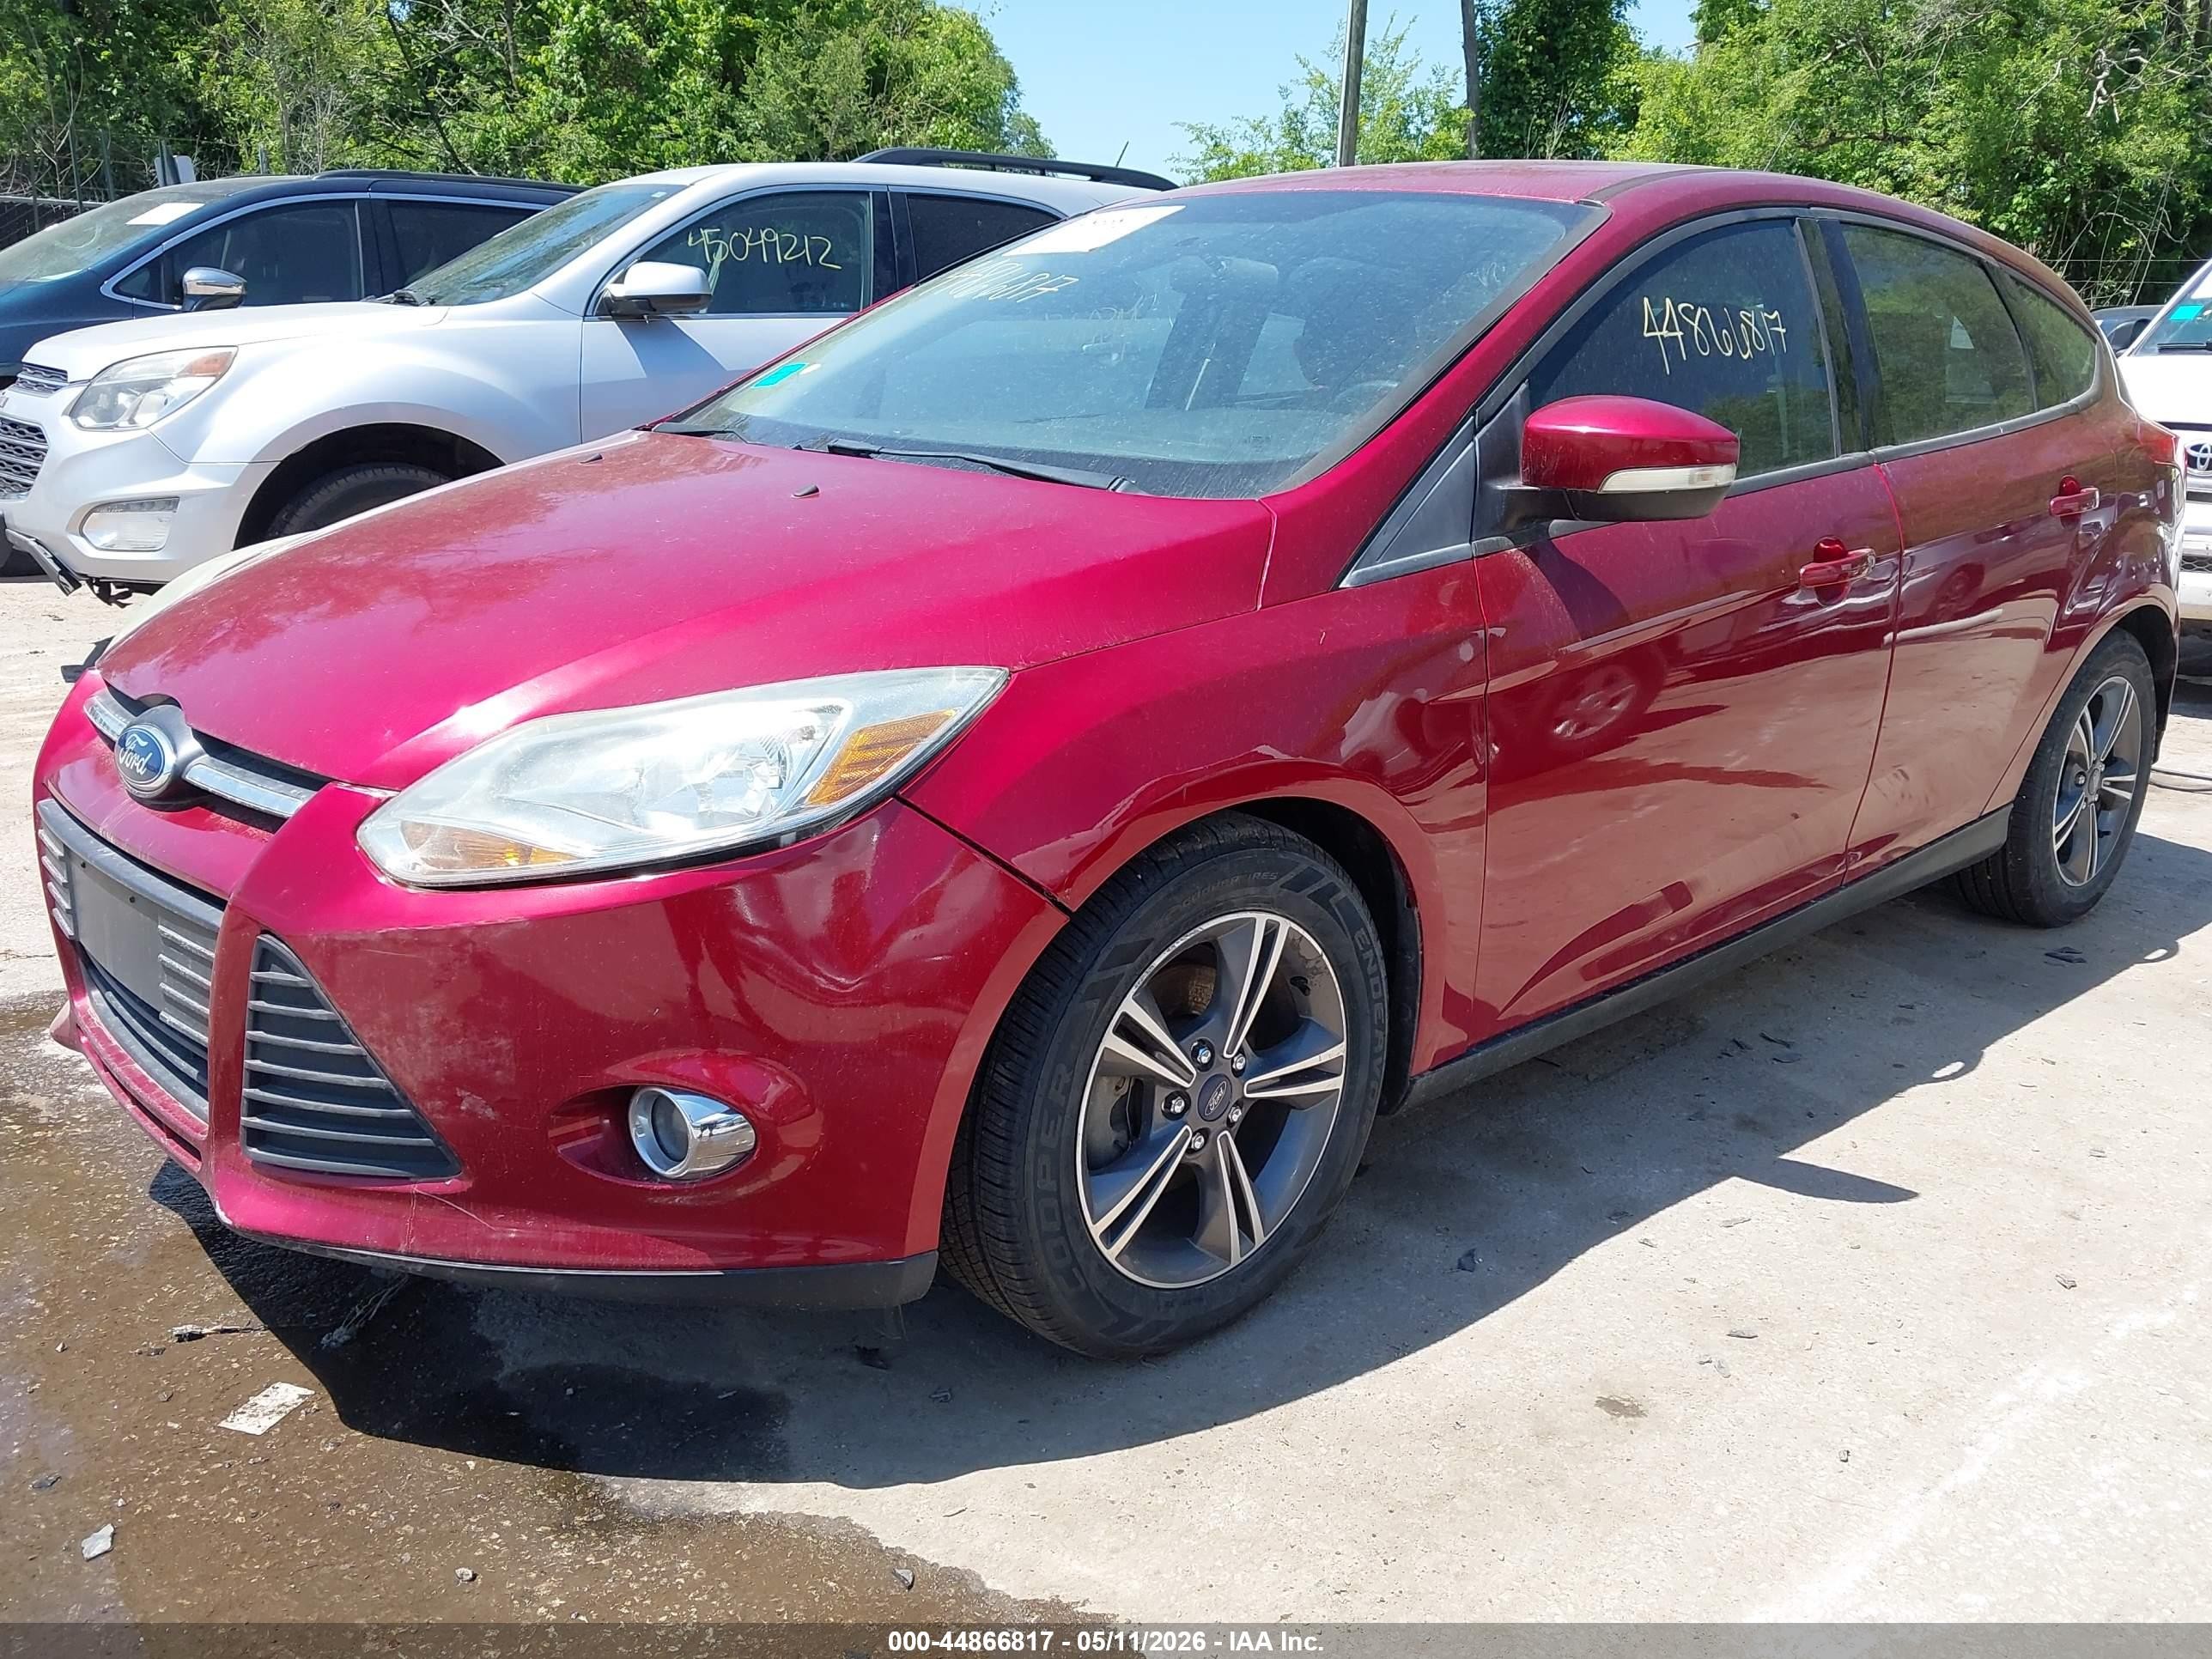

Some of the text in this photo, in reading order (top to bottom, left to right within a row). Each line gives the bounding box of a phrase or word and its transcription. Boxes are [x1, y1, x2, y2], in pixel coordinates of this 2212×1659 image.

[688, 227, 842, 270] 45049212
[1644, 295, 1787, 375] 44866817
[118, 733, 154, 775] Ford
[1353, 927, 1386, 1125] ENDEAVO
[1036, 1062, 1087, 1292] COOPER
